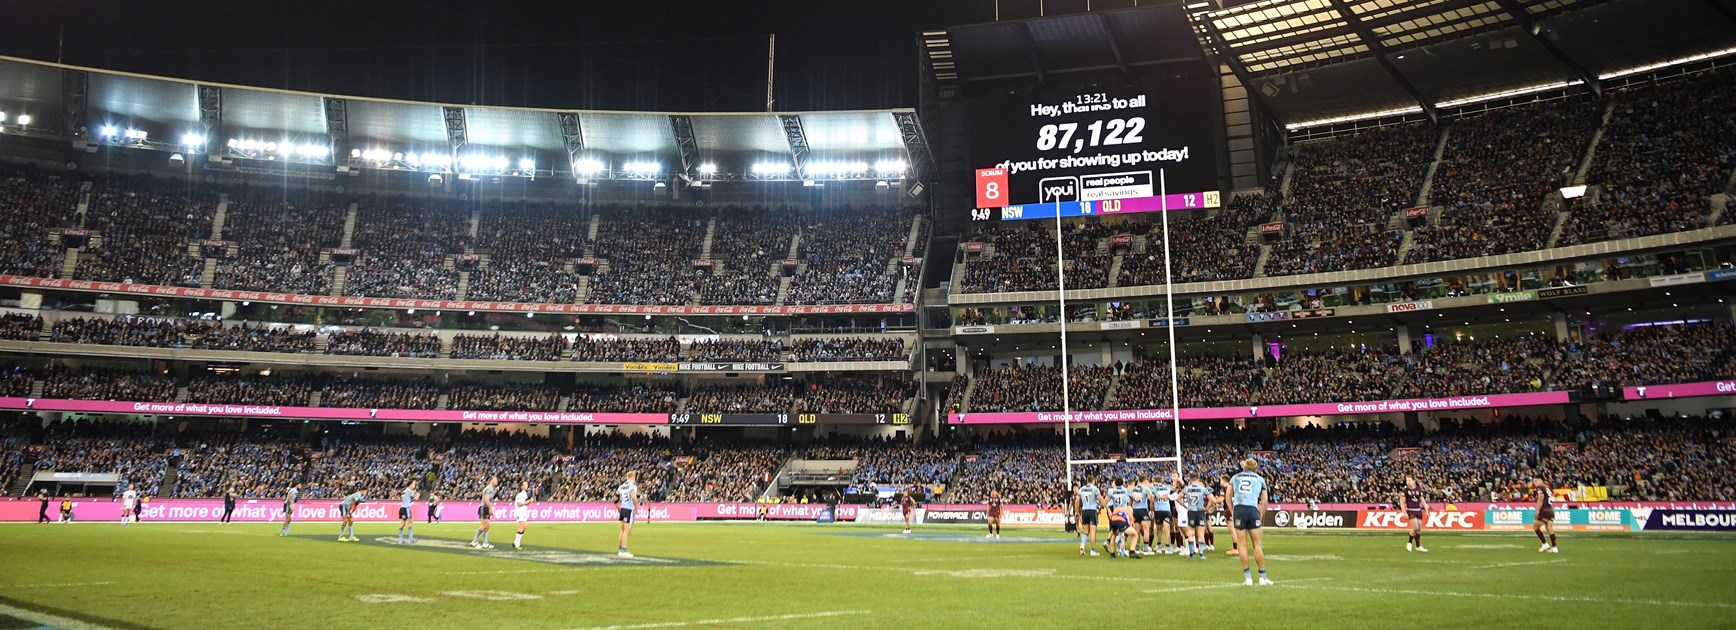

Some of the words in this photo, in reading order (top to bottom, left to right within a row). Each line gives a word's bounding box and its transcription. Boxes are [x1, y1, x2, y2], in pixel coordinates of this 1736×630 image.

[1077, 93, 1107, 104] 13:21
[1030, 104, 1062, 118] Hey,
[1112, 98, 1127, 109] to
[1129, 95, 1146, 108] all
[1037, 117, 1146, 154] 87,122
[1011, 160, 1037, 174] you
[1038, 157, 1058, 169] for
[1059, 153, 1120, 167] showing
[1122, 154, 1141, 166] up
[1142, 147, 1188, 162] today!
[1086, 178, 1103, 186] real
[1104, 176, 1134, 186] people
[986, 182, 999, 199] 8
[1044, 182, 1074, 201] youi
[1104, 190, 1138, 198] savings
[972, 208, 990, 221] 9:49
[1002, 206, 1023, 219] NSW
[1080, 202, 1092, 214] 18
[1102, 200, 1121, 212] QLD
[1184, 195, 1196, 208] 12
[1206, 192, 1219, 205] H2
[1540, 290, 1560, 298] WOLF
[1564, 287, 1587, 296] BLASS
[1716, 382, 1736, 392] Get
[134, 403, 150, 411] Get
[152, 404, 173, 412] more
[175, 404, 185, 412] of
[186, 404, 206, 412] what
[208, 407, 222, 415] you
[226, 406, 242, 414] love
[244, 406, 281, 415] included.
[1338, 404, 1353, 412] Get
[1378, 402, 1388, 410] of
[1388, 402, 1410, 410] what
[1412, 402, 1428, 411] you
[1430, 398, 1448, 407] love
[1449, 398, 1490, 406] included.
[500, 412, 510, 420] of
[510, 412, 528, 420] what
[528, 414, 542, 422] you
[561, 414, 594, 422] included.
[671, 414, 690, 424] 9:49
[702, 414, 722, 423] NSW
[778, 414, 788, 424] 18
[798, 414, 816, 424] QLD
[875, 414, 886, 424] 12
[896, 414, 907, 424] H2
[1074, 412, 1084, 422] of
[1104, 414, 1118, 422] you
[1120, 412, 1136, 420] love
[1137, 410, 1172, 419] included.
[1239, 479, 1252, 493] 2
[1115, 496, 1122, 505] 4
[1190, 493, 1199, 506] 7
[140, 503, 164, 518] Get
[169, 506, 208, 518] more
[231, 504, 267, 518] what
[268, 508, 287, 521] yo
[298, 505, 326, 518] love
[329, 505, 388, 518] inuded.
[540, 506, 552, 519] of
[554, 506, 580, 519] what
[582, 509, 601, 522] you
[603, 506, 619, 519] lov
[634, 507, 670, 519] cluded.
[718, 504, 736, 516] Get
[740, 506, 762, 516] mor
[770, 504, 780, 516] of
[782, 504, 809, 516] what
[810, 507, 826, 518] yo
[835, 507, 855, 516] ove
[927, 512, 968, 520] POWERADE
[1492, 510, 1522, 521] HOME
[1588, 510, 1621, 521] HOME
[1294, 512, 1343, 526] Holden
[1363, 512, 1409, 528] KFC
[1425, 512, 1477, 528] KFC
